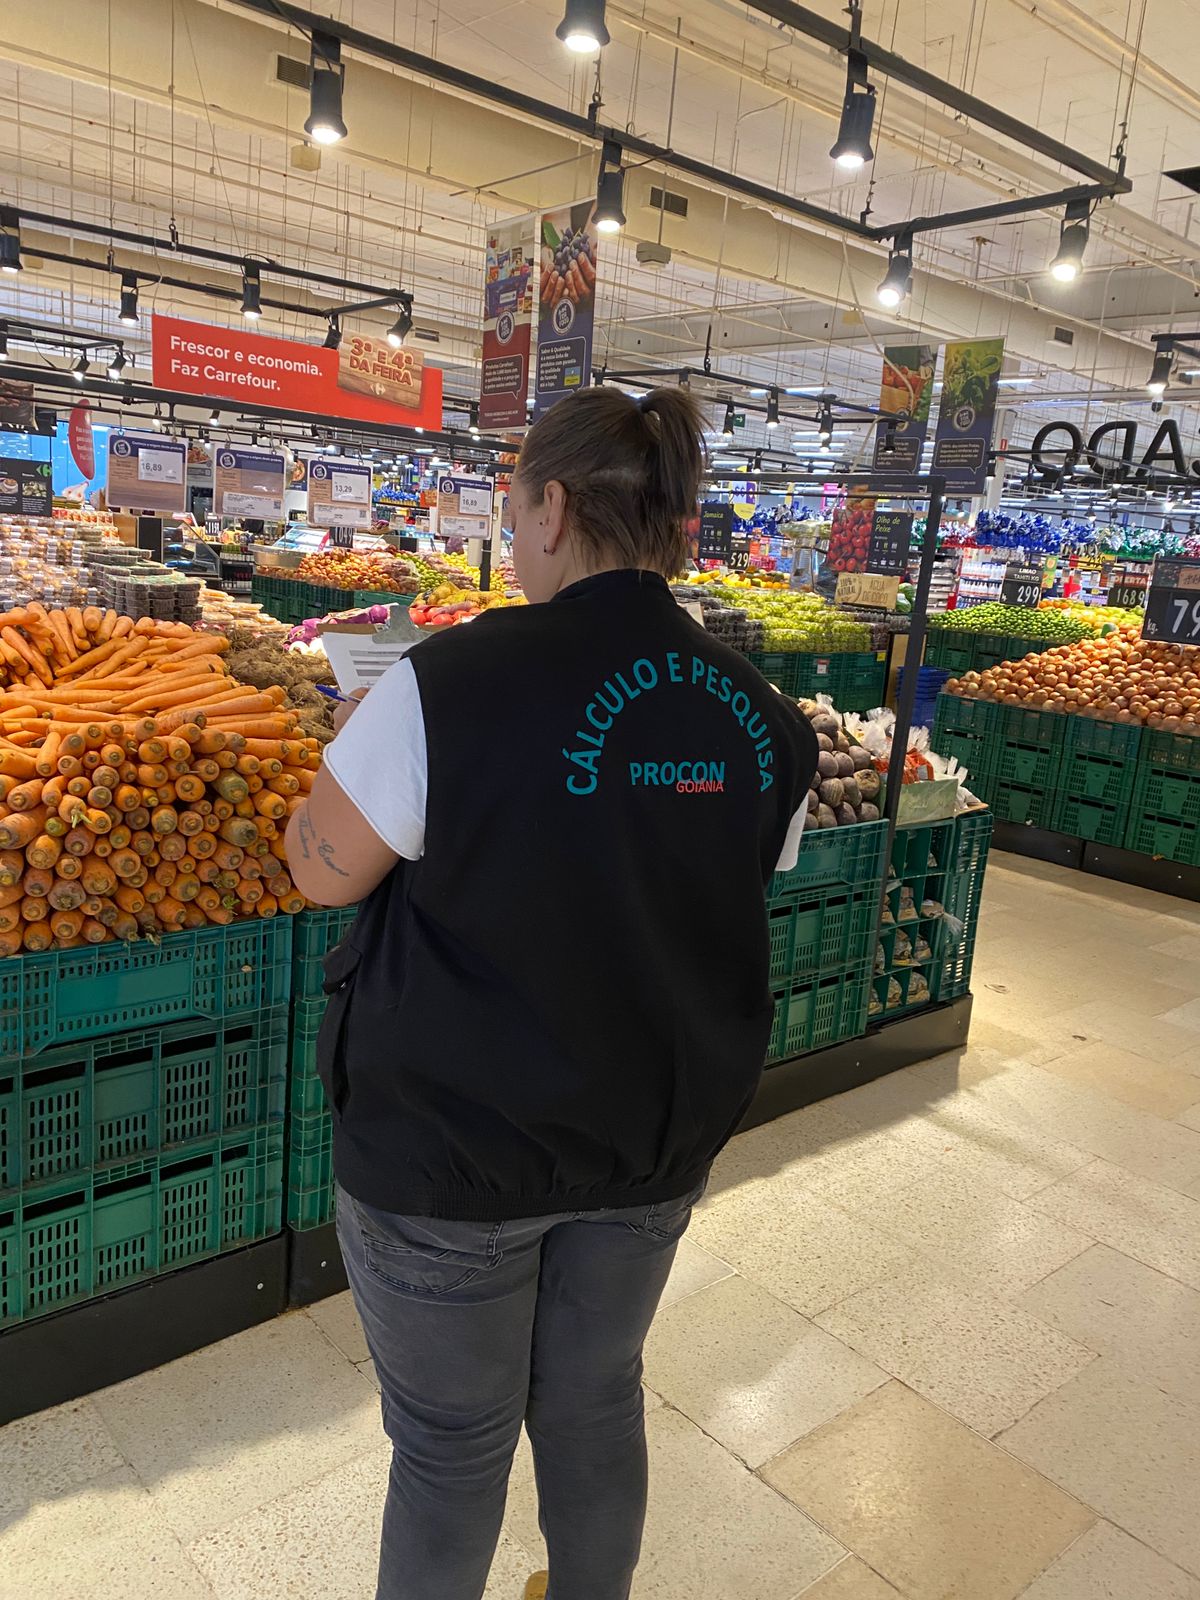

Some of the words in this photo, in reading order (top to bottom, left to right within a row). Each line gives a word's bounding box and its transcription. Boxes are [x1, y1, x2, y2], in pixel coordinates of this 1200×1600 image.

[170, 335, 230, 360] Frescor
[234, 350, 244, 362] e
[247, 351, 323, 377] economia.
[377, 348, 387, 364] E
[171, 359, 199, 378] Faz
[203, 366, 281, 391] Carrefour.
[350, 355, 371, 374] DA
[372, 362, 412, 386] FEIRA
[141, 462, 162, 472] 16,89
[335, 485, 353, 493] 13,29
[462, 498, 477, 507] 16,89
[875, 524, 891, 533] Peixe
[876, 516, 891, 524] Olho
[892, 517, 901, 525] de
[730, 552, 749, 569] 529
[1017, 585, 1039, 604] 299
[1116, 588, 1146, 606] 1689
[561, 657, 659, 795] CÁLCULO
[666, 652, 684, 683] E
[691, 655, 774, 792] PESQUISA
[629, 761, 725, 786] PROCON
